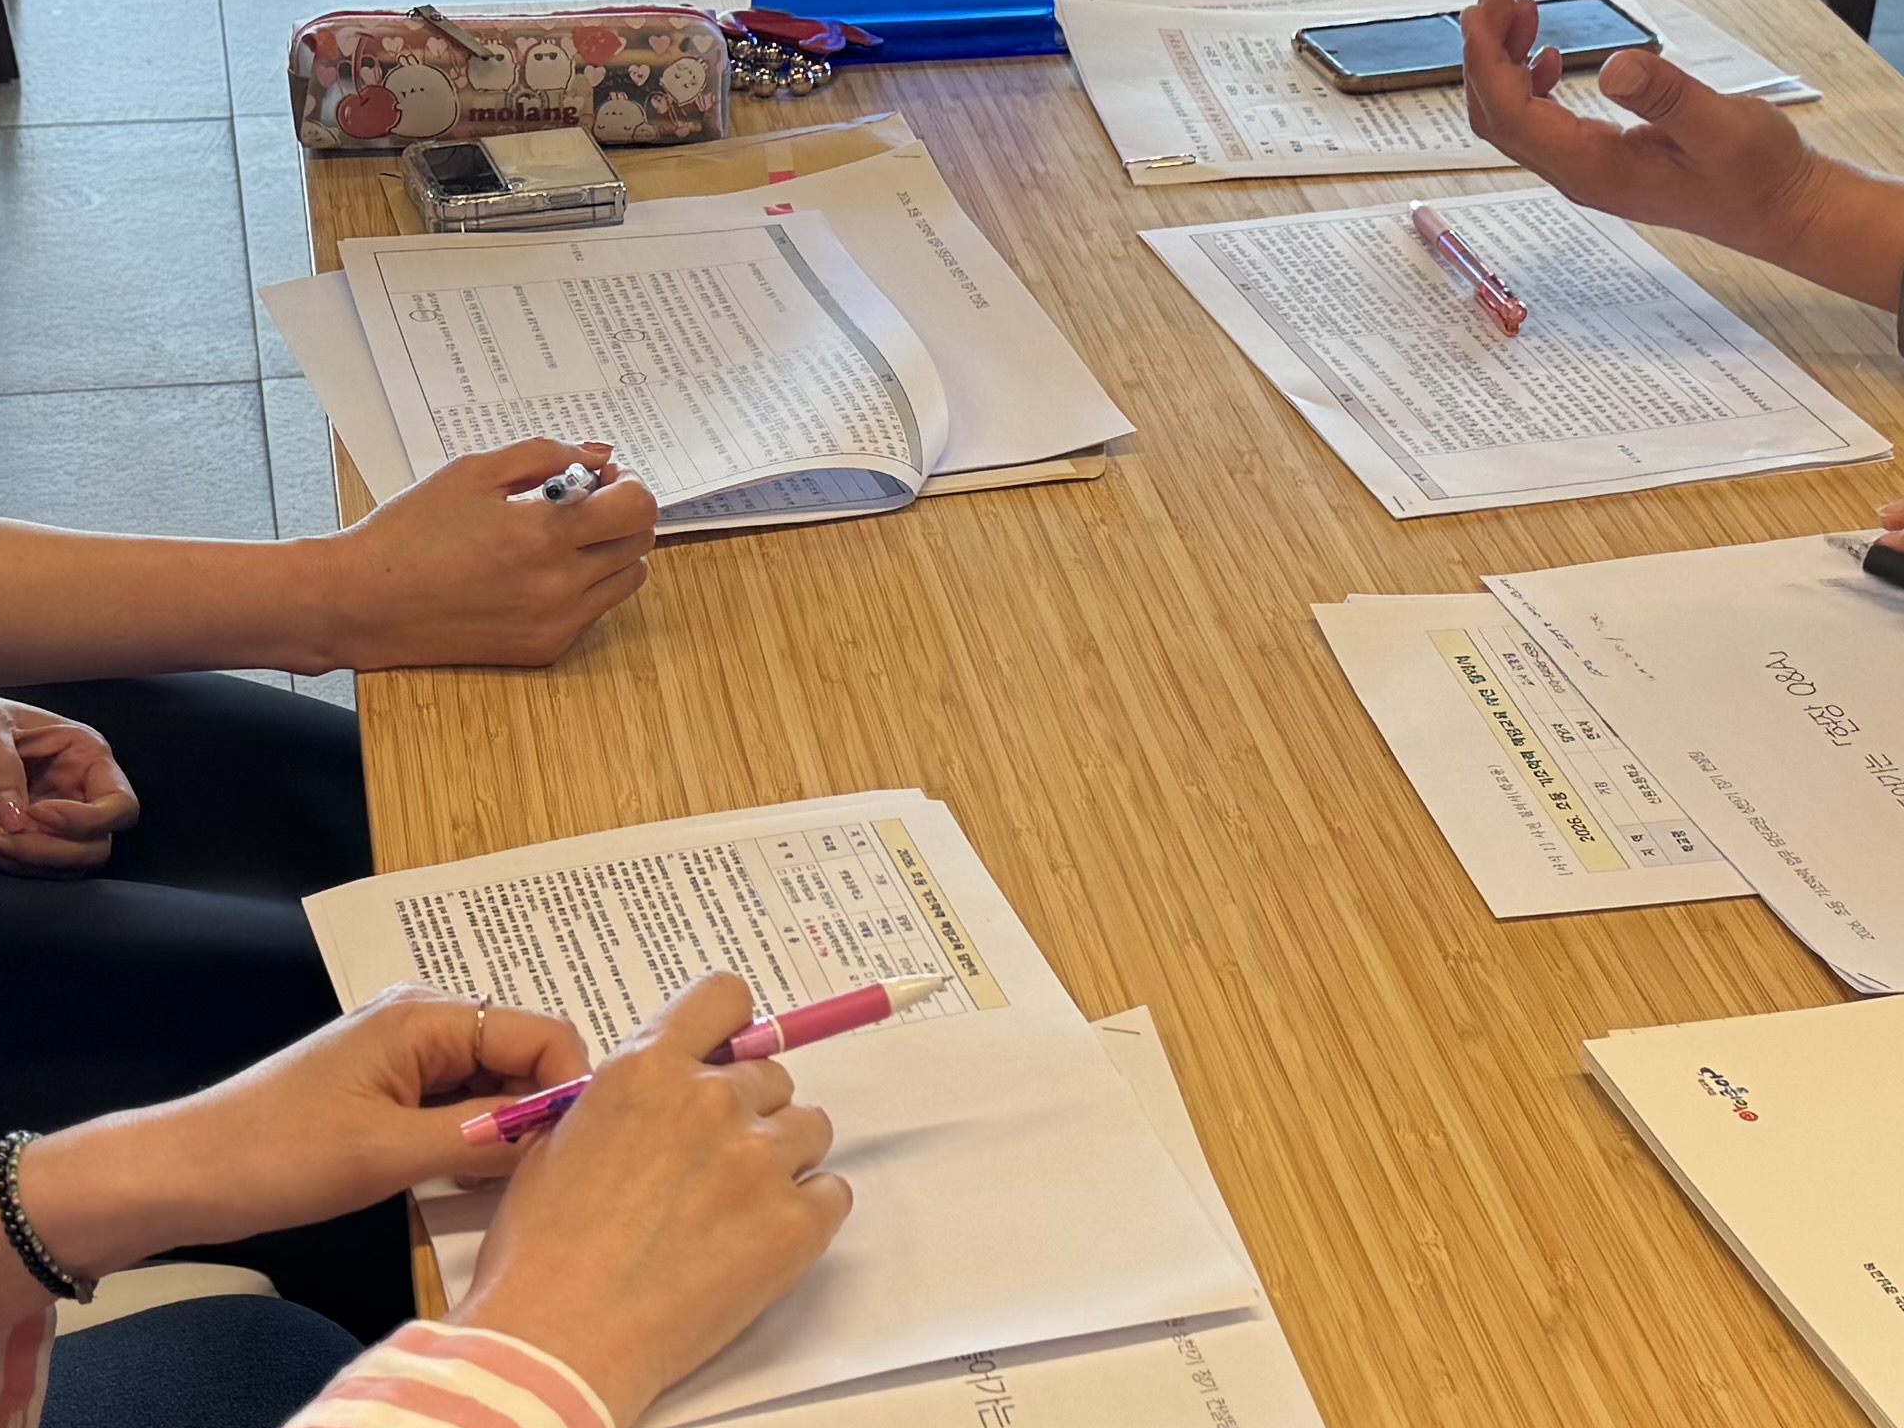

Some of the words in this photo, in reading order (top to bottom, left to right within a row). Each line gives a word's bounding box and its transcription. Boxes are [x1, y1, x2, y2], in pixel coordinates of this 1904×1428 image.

[468, 102, 580, 125] molang
[1566, 814, 1596, 843] 2026.
[1192, 1369, 1219, 1394] 정기
